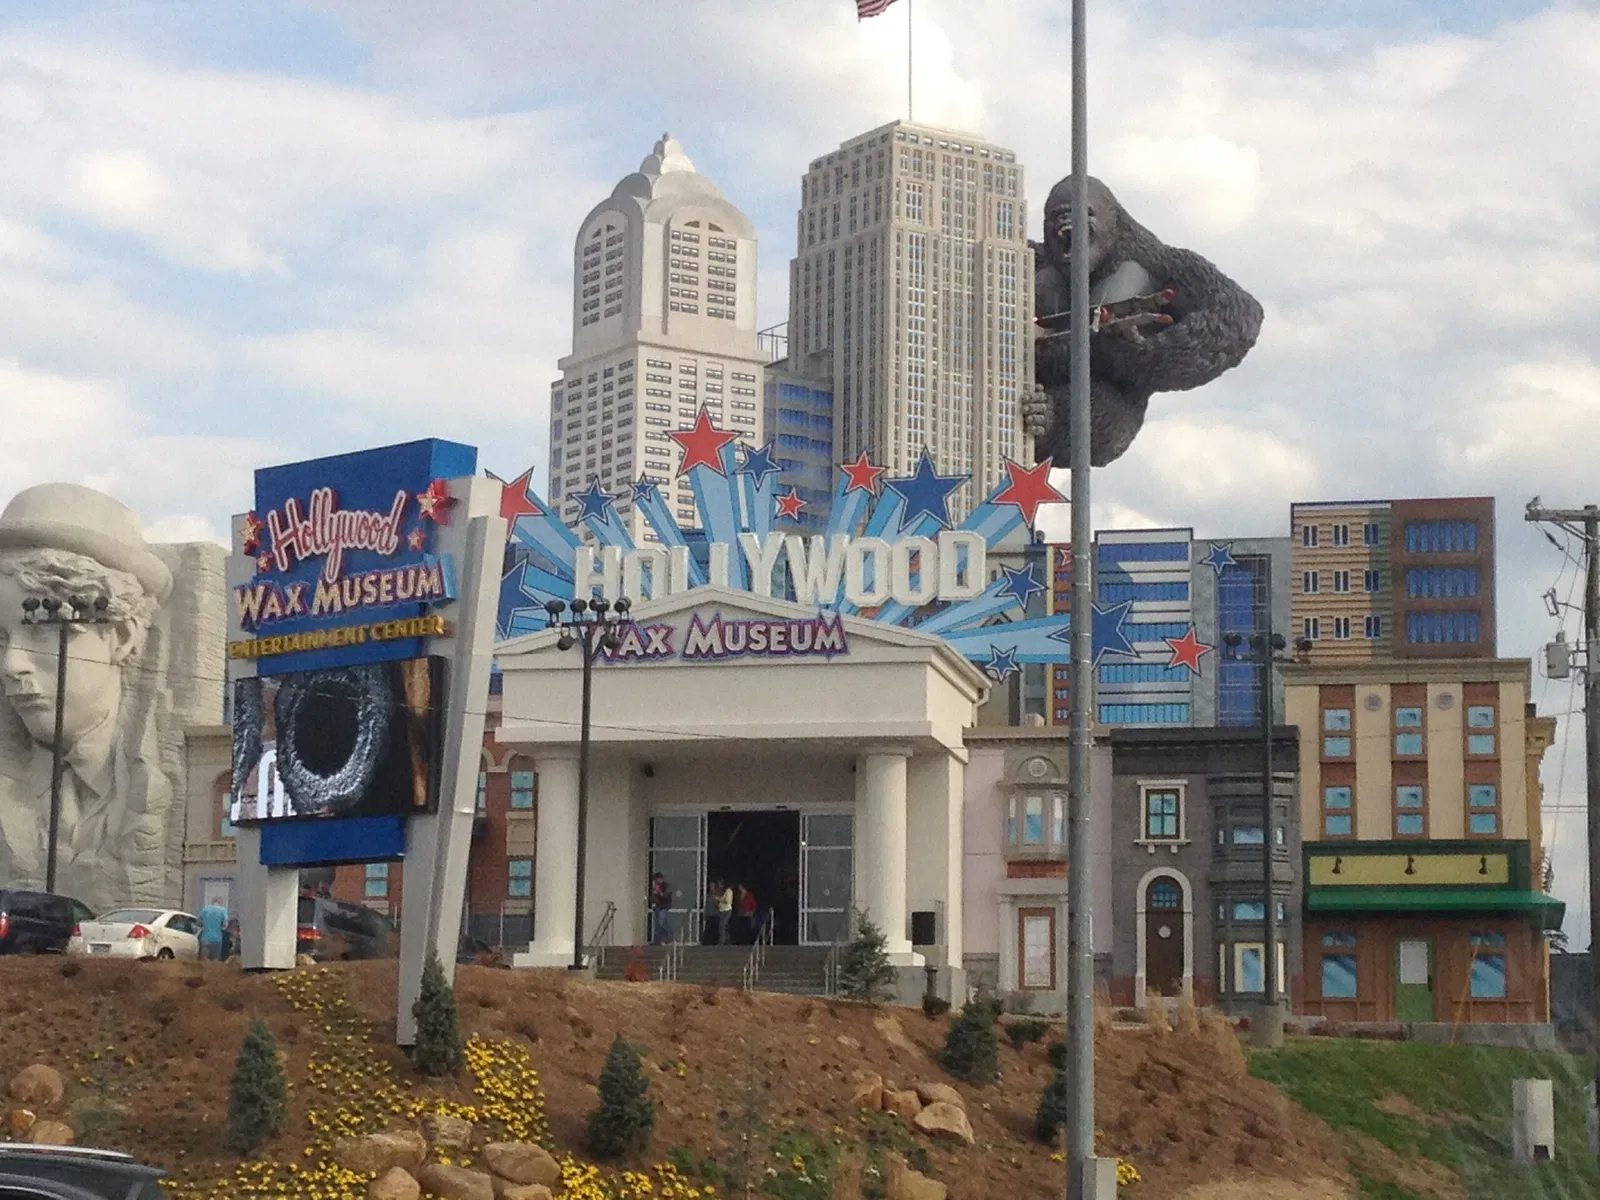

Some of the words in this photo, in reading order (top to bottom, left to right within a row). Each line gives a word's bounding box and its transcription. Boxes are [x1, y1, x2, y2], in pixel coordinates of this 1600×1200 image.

[267, 487, 406, 583] Hollywood
[233, 580, 309, 625] WAX
[310, 561, 443, 616] MUSEUM
[228, 627, 368, 658] ENTERTAINMENT
[369, 616, 446, 641] CENTER
[684, 614, 850, 656] MUSEUM
